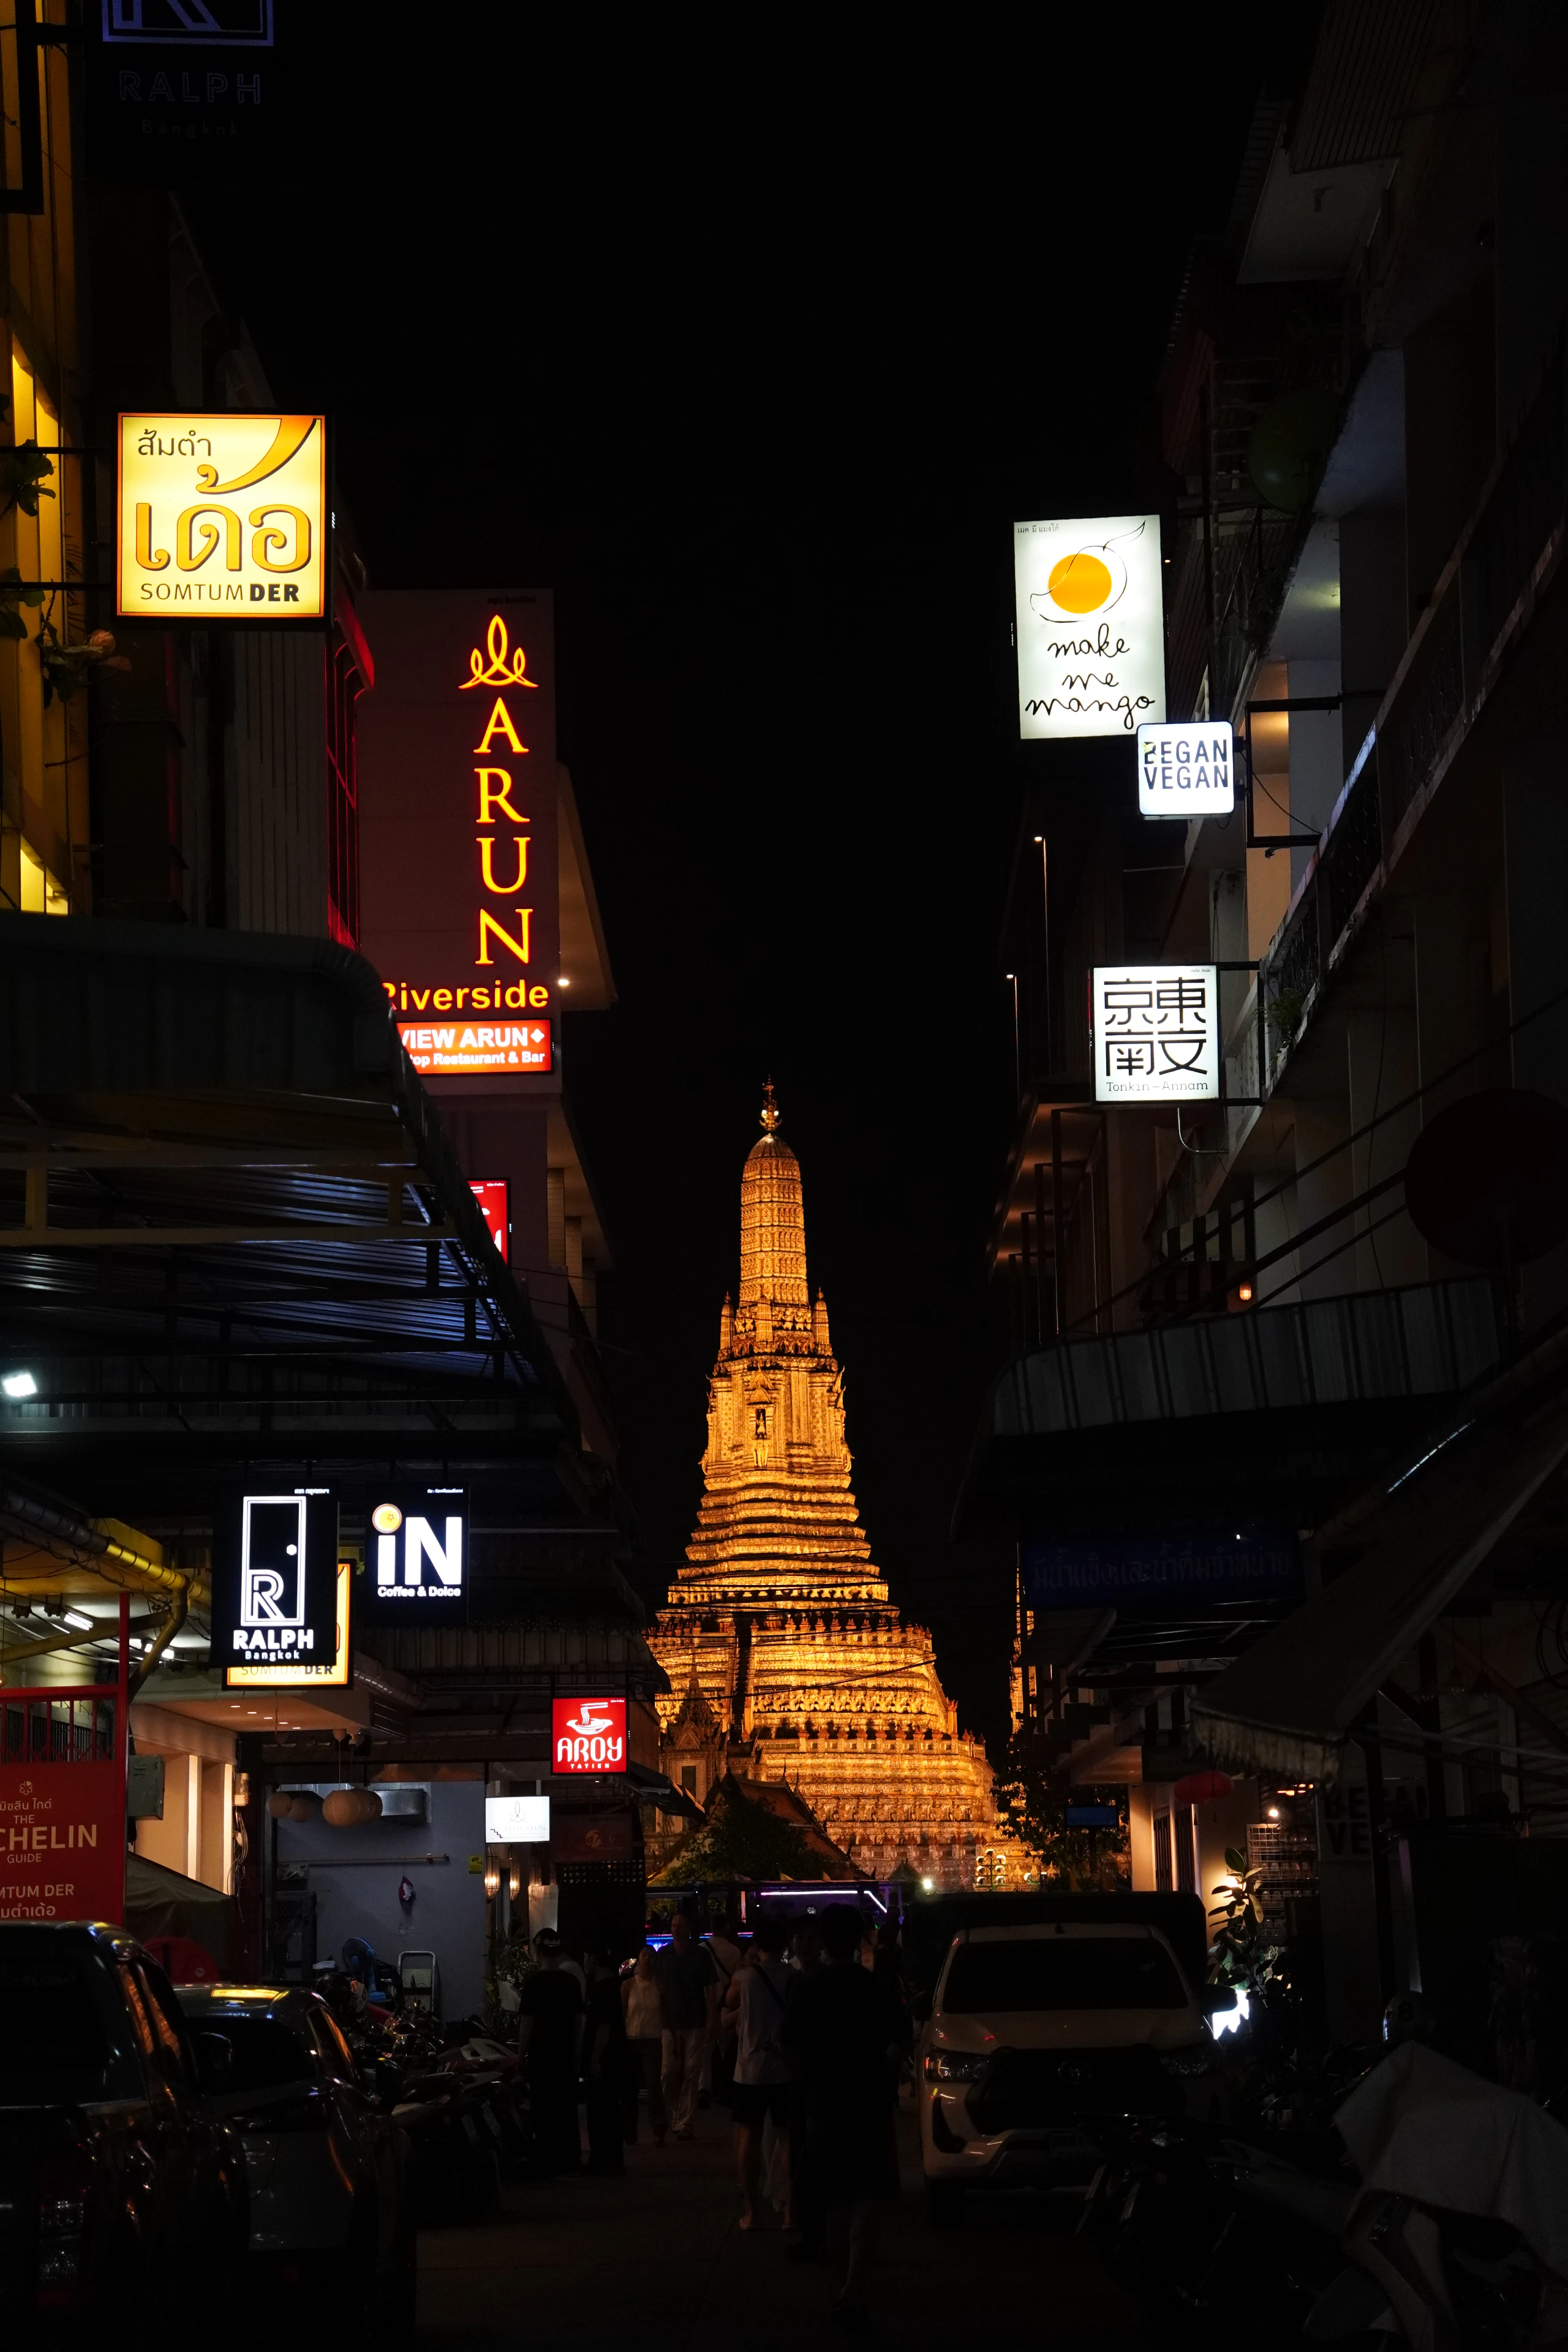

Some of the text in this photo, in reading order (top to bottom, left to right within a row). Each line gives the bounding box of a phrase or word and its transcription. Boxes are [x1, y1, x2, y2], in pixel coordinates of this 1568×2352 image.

[119, 70, 261, 104] RALPH
[141, 119, 239, 139] Bangkok
[138, 429, 211, 457] ส้มตำ
[135, 419, 315, 574] เด้อ
[1047, 623, 1130, 658] make
[1061, 673, 1119, 690] me
[1025, 696, 1155, 729] mango
[1142, 739, 1227, 764] BEGAN
[1144, 765, 1229, 790] VEGAN
[473, 697, 533, 965] ARUN
[459, 1028, 528, 1048] ARUN
[433, 1052, 505, 1065] Restaurant
[508, 1051, 518, 1063] &
[521, 1051, 545, 1063] Bar
[377, 1586, 461, 1597] Coffee & Dolce
[233, 1629, 314, 1649] RALPH
[245, 1650, 300, 1662] Bangkok
[557, 1736, 622, 1762] AROY
[32, 1798, 52, 1810] ไกด์
[13, 1815, 35, 1824] THE
[7, 1853, 42, 1864] GUIDE
[45, 1883, 75, 1897] DER
